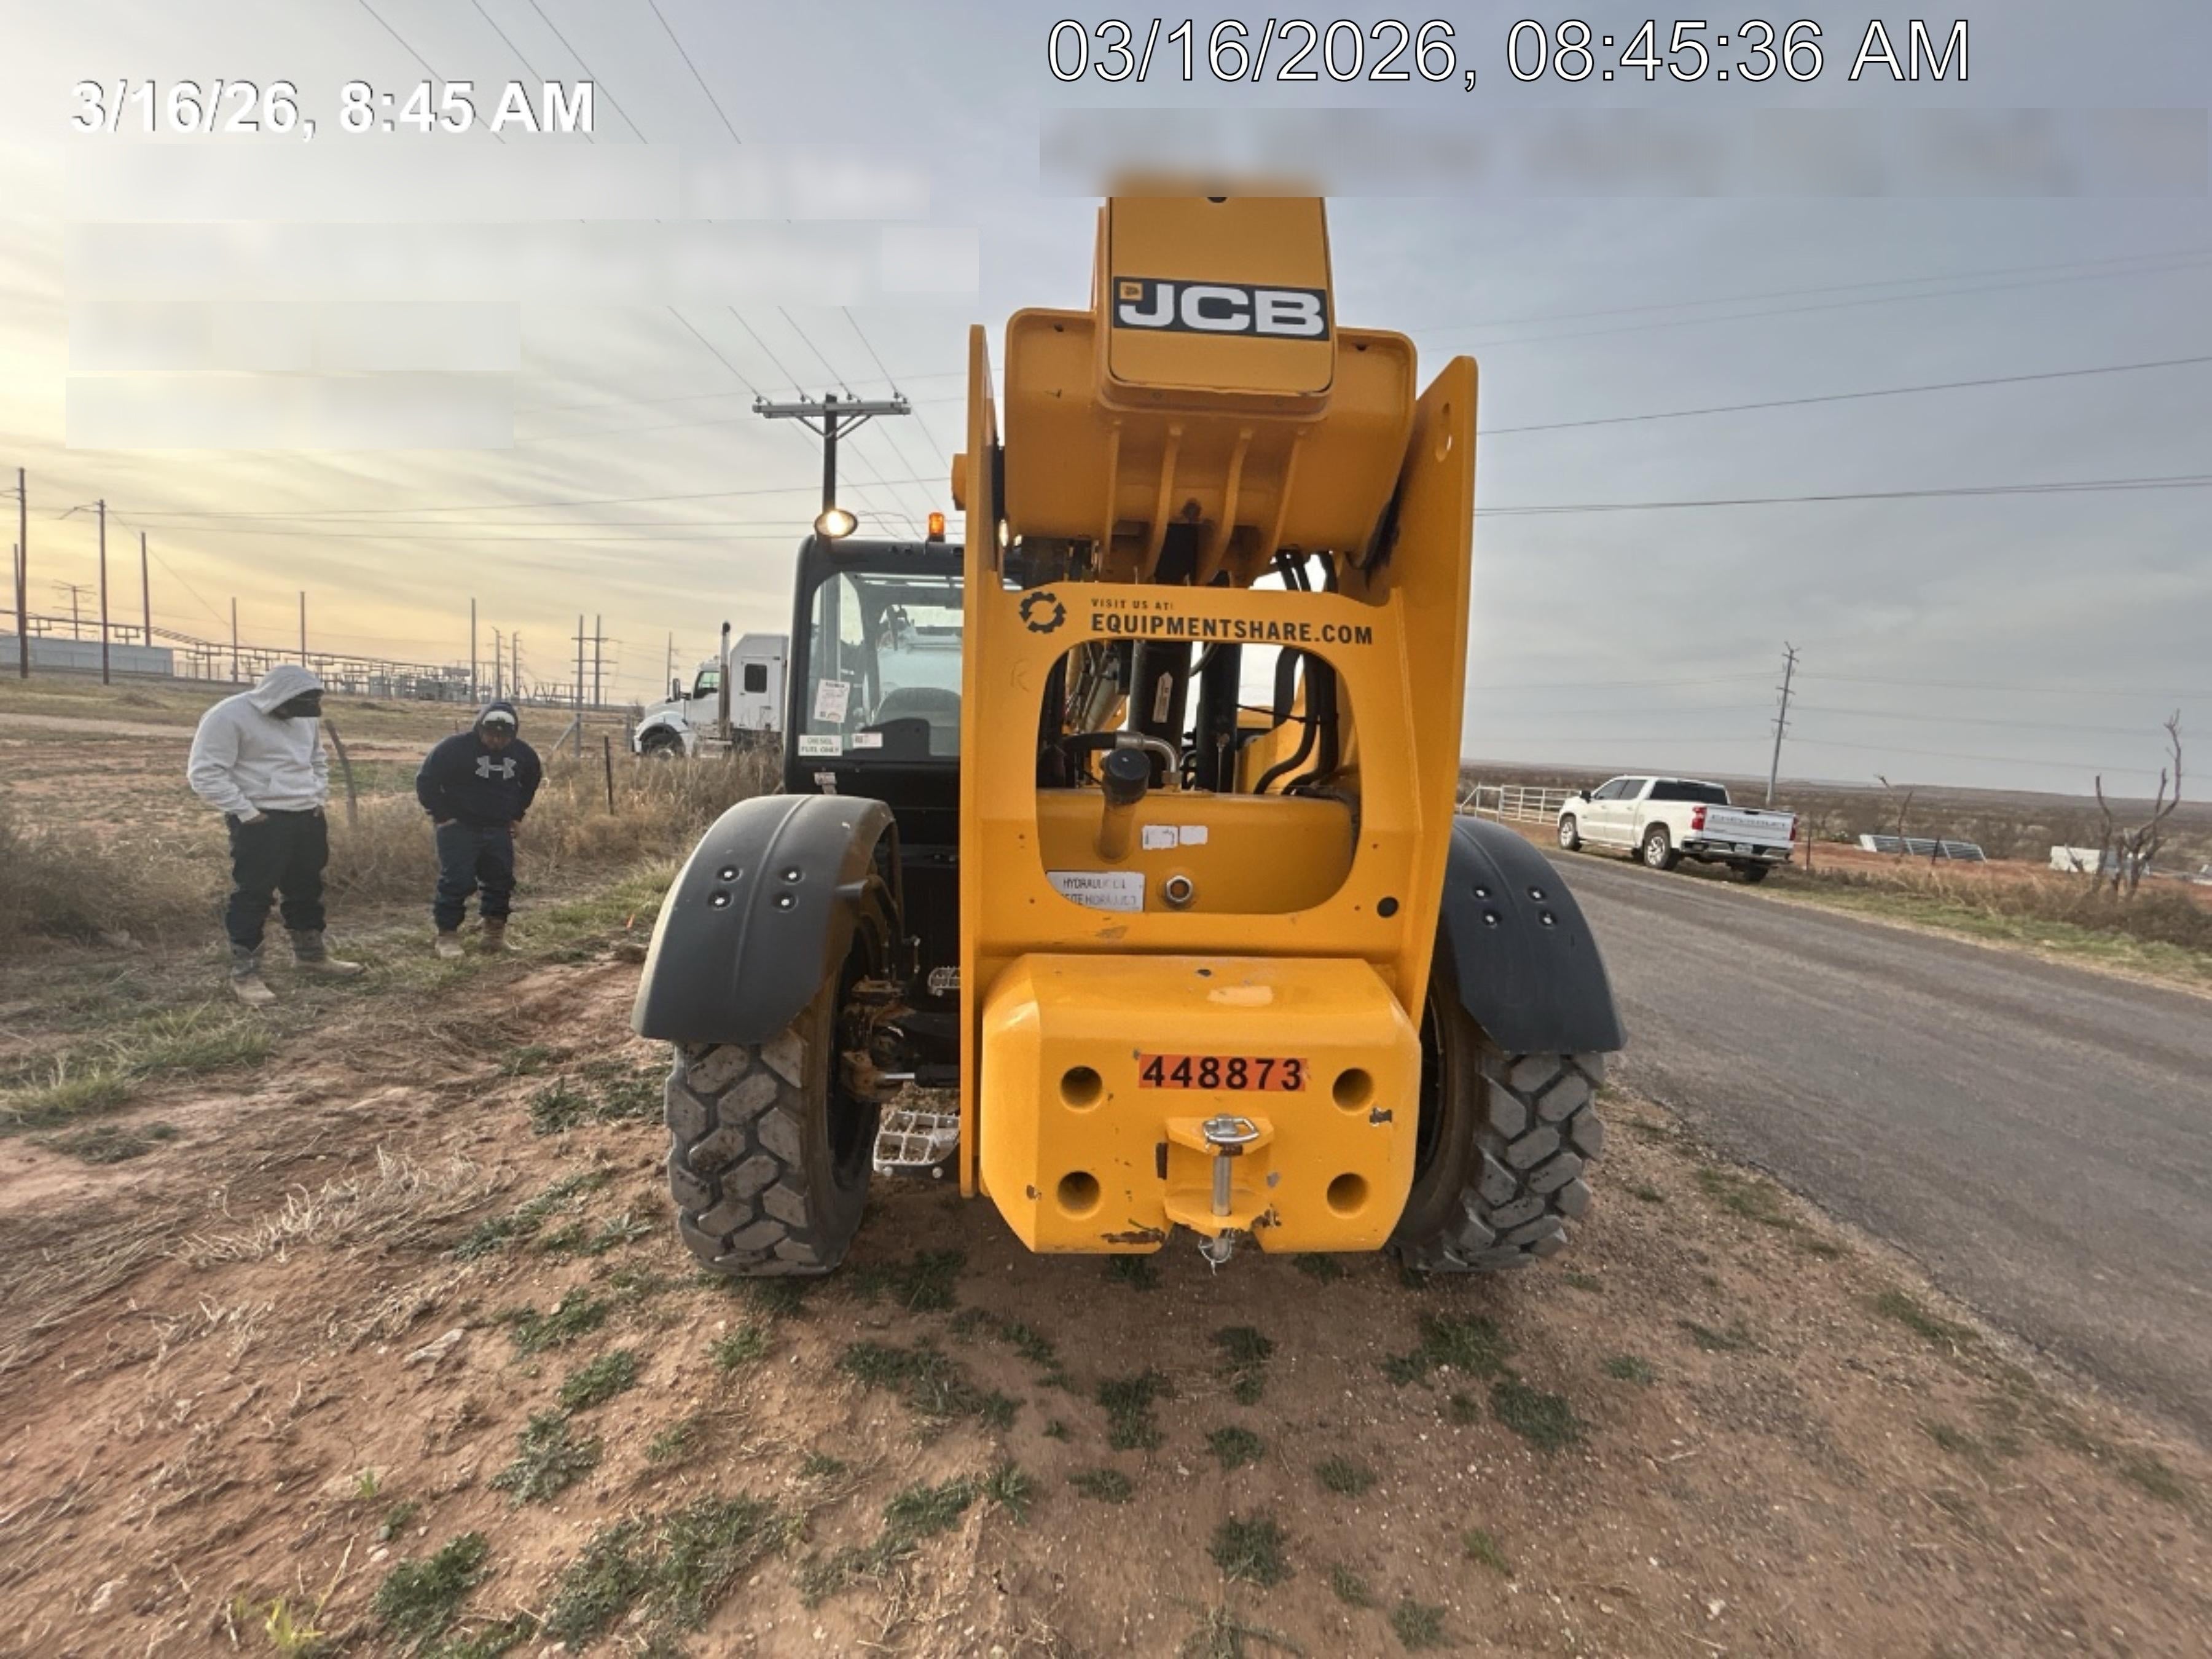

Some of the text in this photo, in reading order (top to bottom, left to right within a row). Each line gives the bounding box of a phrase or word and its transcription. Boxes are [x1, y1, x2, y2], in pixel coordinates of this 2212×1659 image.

[1119, 283, 1324, 336] JCB
[1091, 598, 1126, 609] VISIT
[1132, 600, 1148, 609] US
[1091, 613, 1372, 645] EQUIPMENTSHARE.COM
[1142, 1056, 1301, 1091] 448873
